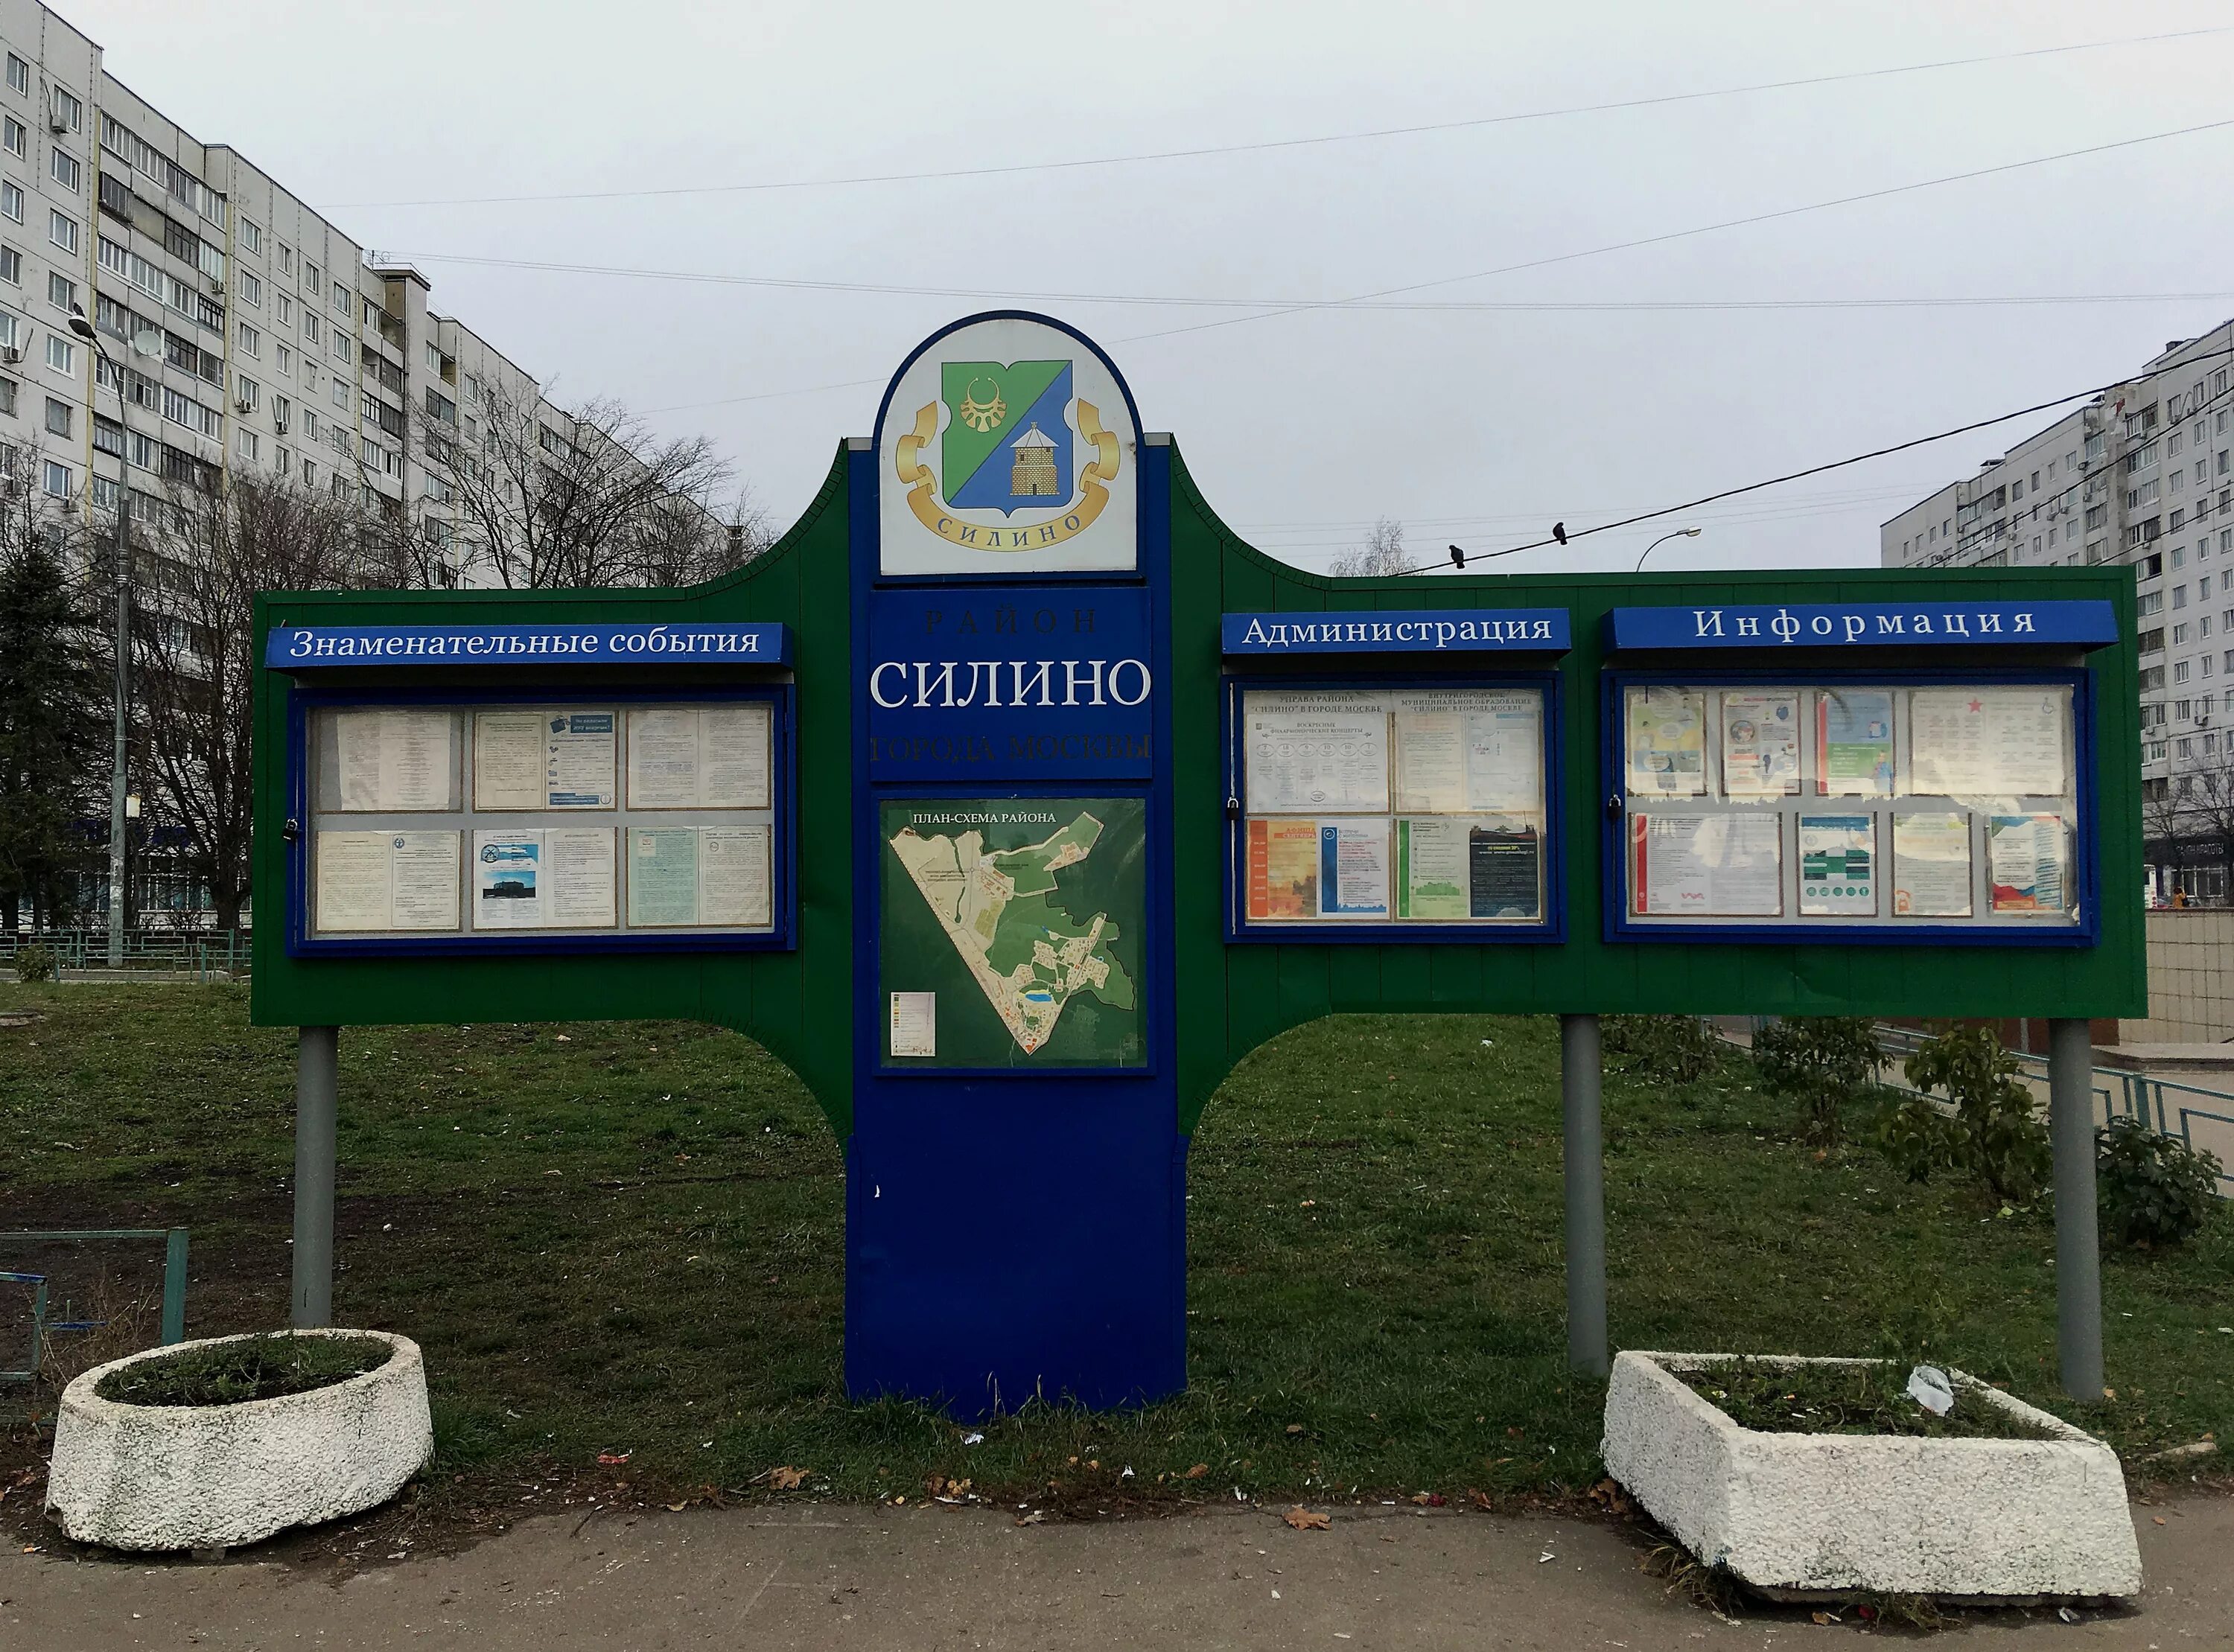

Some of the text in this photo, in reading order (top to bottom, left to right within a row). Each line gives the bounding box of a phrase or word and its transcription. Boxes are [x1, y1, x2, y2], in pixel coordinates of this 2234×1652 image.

[938, 515, 1081, 547] СИЛИНО
[925, 604, 1096, 634] РАЙОН
[1241, 618, 1553, 649] Администрация
[1693, 609, 2037, 643] Информация
[290, 625, 760, 657] Знаменательные события
[870, 659, 1152, 708] СИЛИНО
[1308, 705, 1343, 713] ГОРОДЕ
[870, 733, 1152, 764] ГОРОДА МОСКВЫ
[913, 811, 1057, 824] ПЛАН-СХЕМА РАЙОНА
